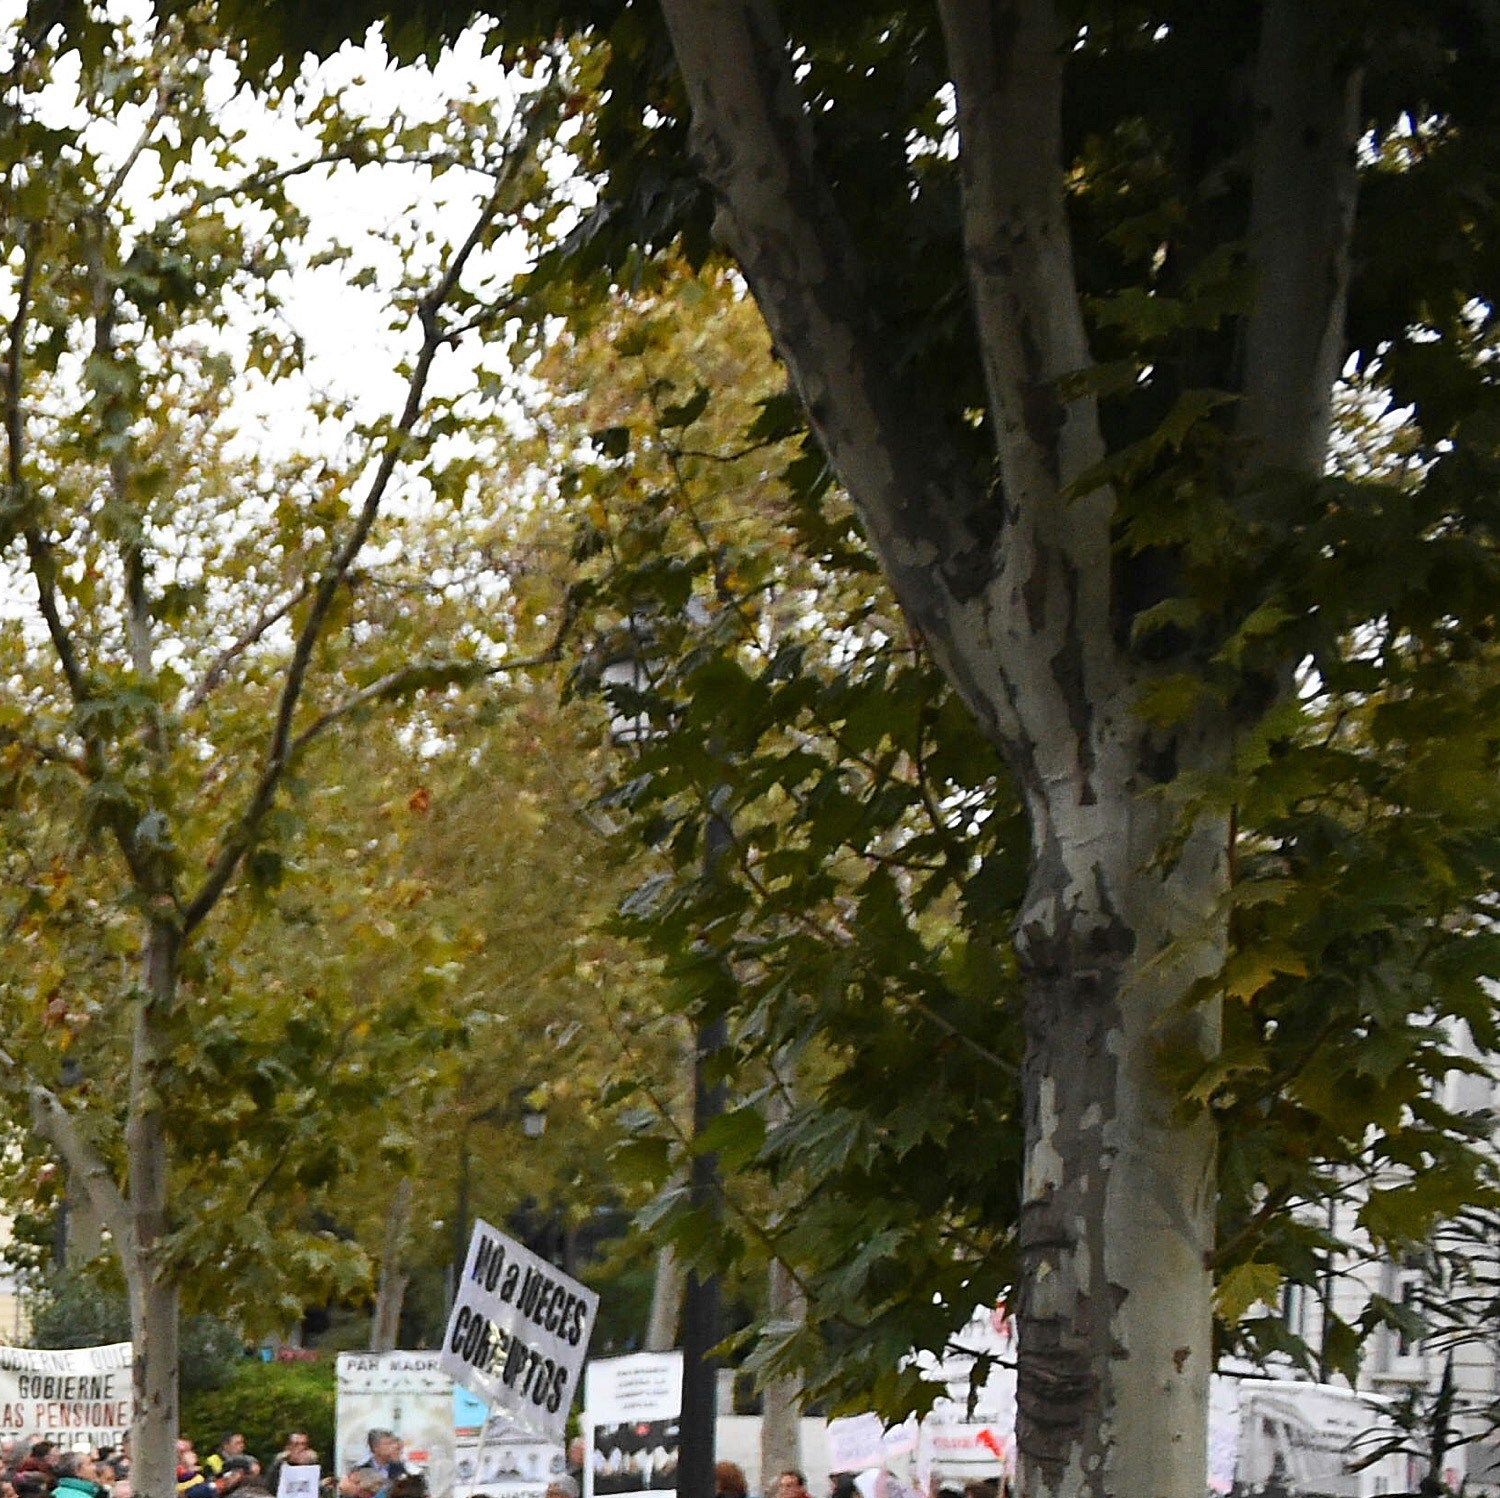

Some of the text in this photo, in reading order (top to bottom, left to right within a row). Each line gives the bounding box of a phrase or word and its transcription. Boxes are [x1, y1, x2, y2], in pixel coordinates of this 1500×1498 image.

[471, 1235, 587, 1347] NO a JUECES
[90, 1344, 132, 1370] QUIE
[18, 1373, 115, 1401] GOBIERNE
[35, 1400, 129, 1429] PENSIONE
